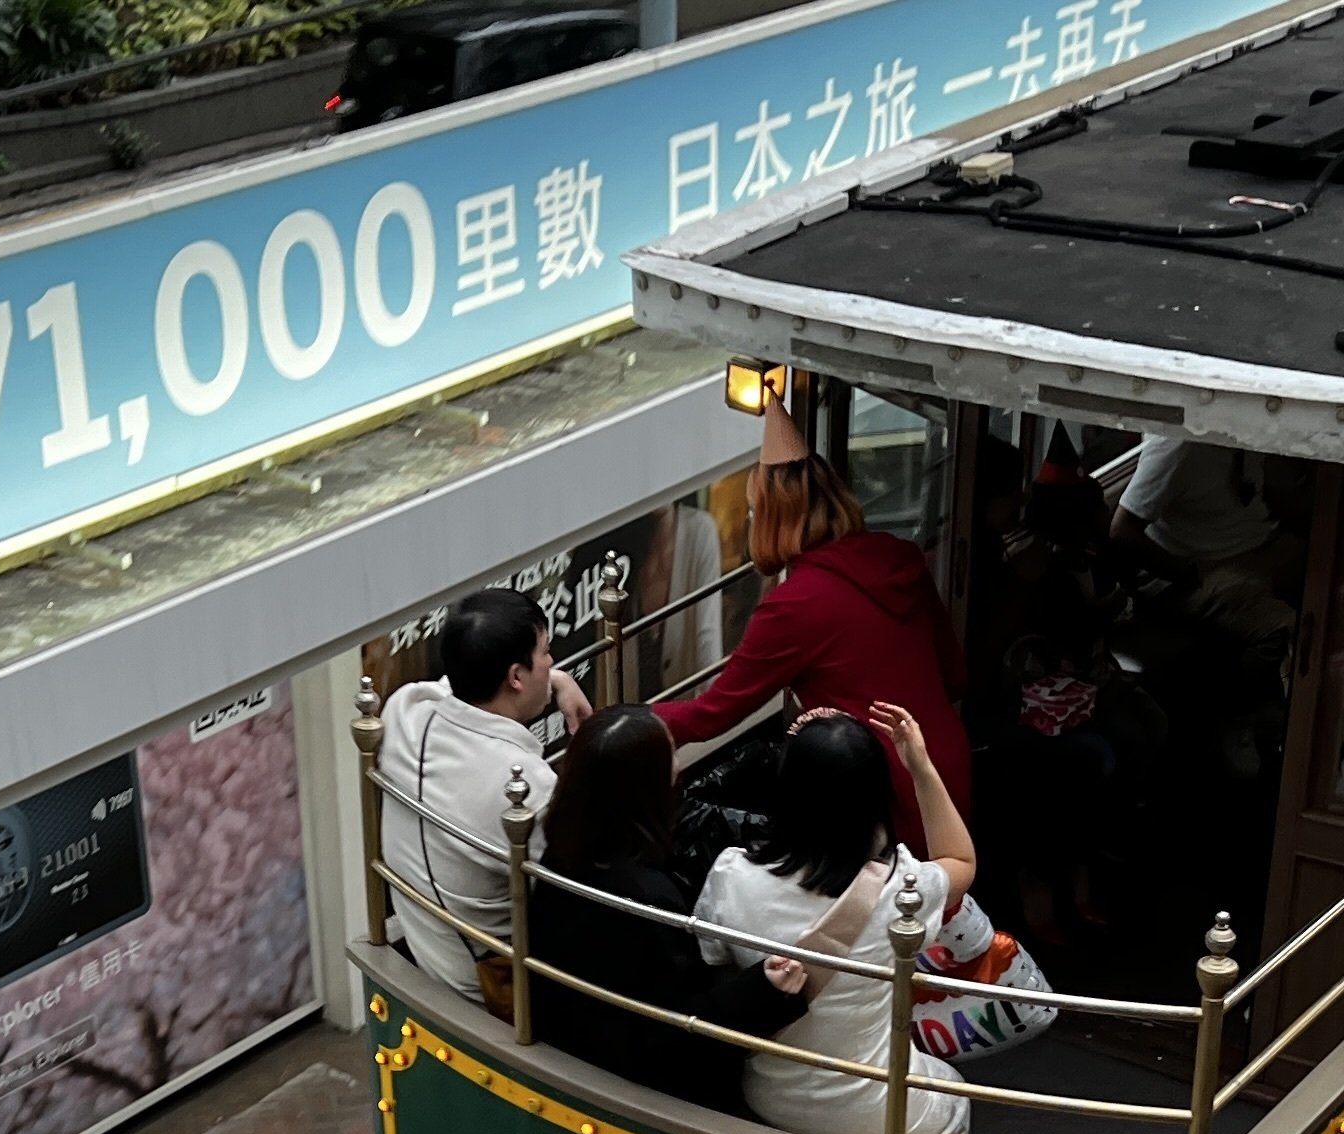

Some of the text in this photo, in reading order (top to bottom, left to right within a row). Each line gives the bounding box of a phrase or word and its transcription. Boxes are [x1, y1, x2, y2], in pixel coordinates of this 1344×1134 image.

[668, 57, 919, 236] 日本之旅
[40, 832, 101, 878] 21001
[912, 1000, 1026, 1058] DAY!
